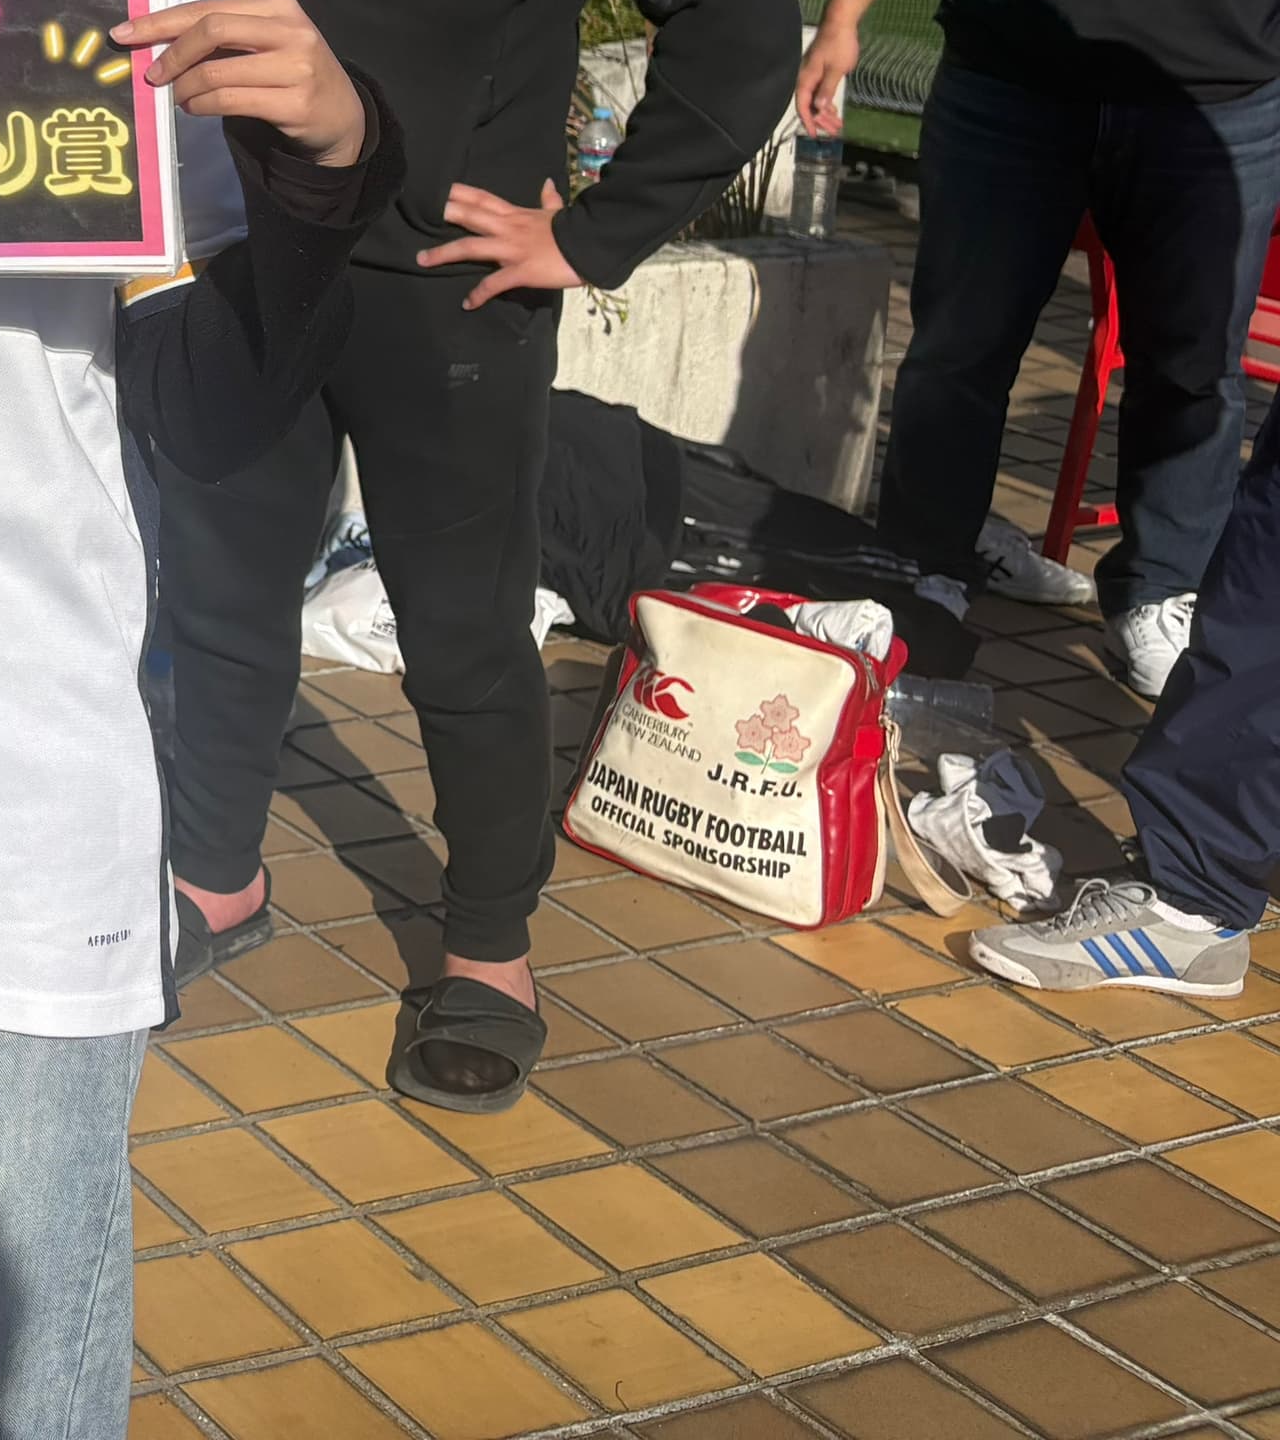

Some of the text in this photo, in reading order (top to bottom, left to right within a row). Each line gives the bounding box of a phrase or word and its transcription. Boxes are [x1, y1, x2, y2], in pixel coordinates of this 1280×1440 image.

[620, 719, 646, 741] NEW
[647, 730, 703, 763] ZEALAND
[622, 703, 690, 744] CANTERBURY
[587, 760, 808, 857] JAPAN RUGBY FOOTBALL
[591, 795, 792, 880] OFFICIAL SPONSORSHIP
